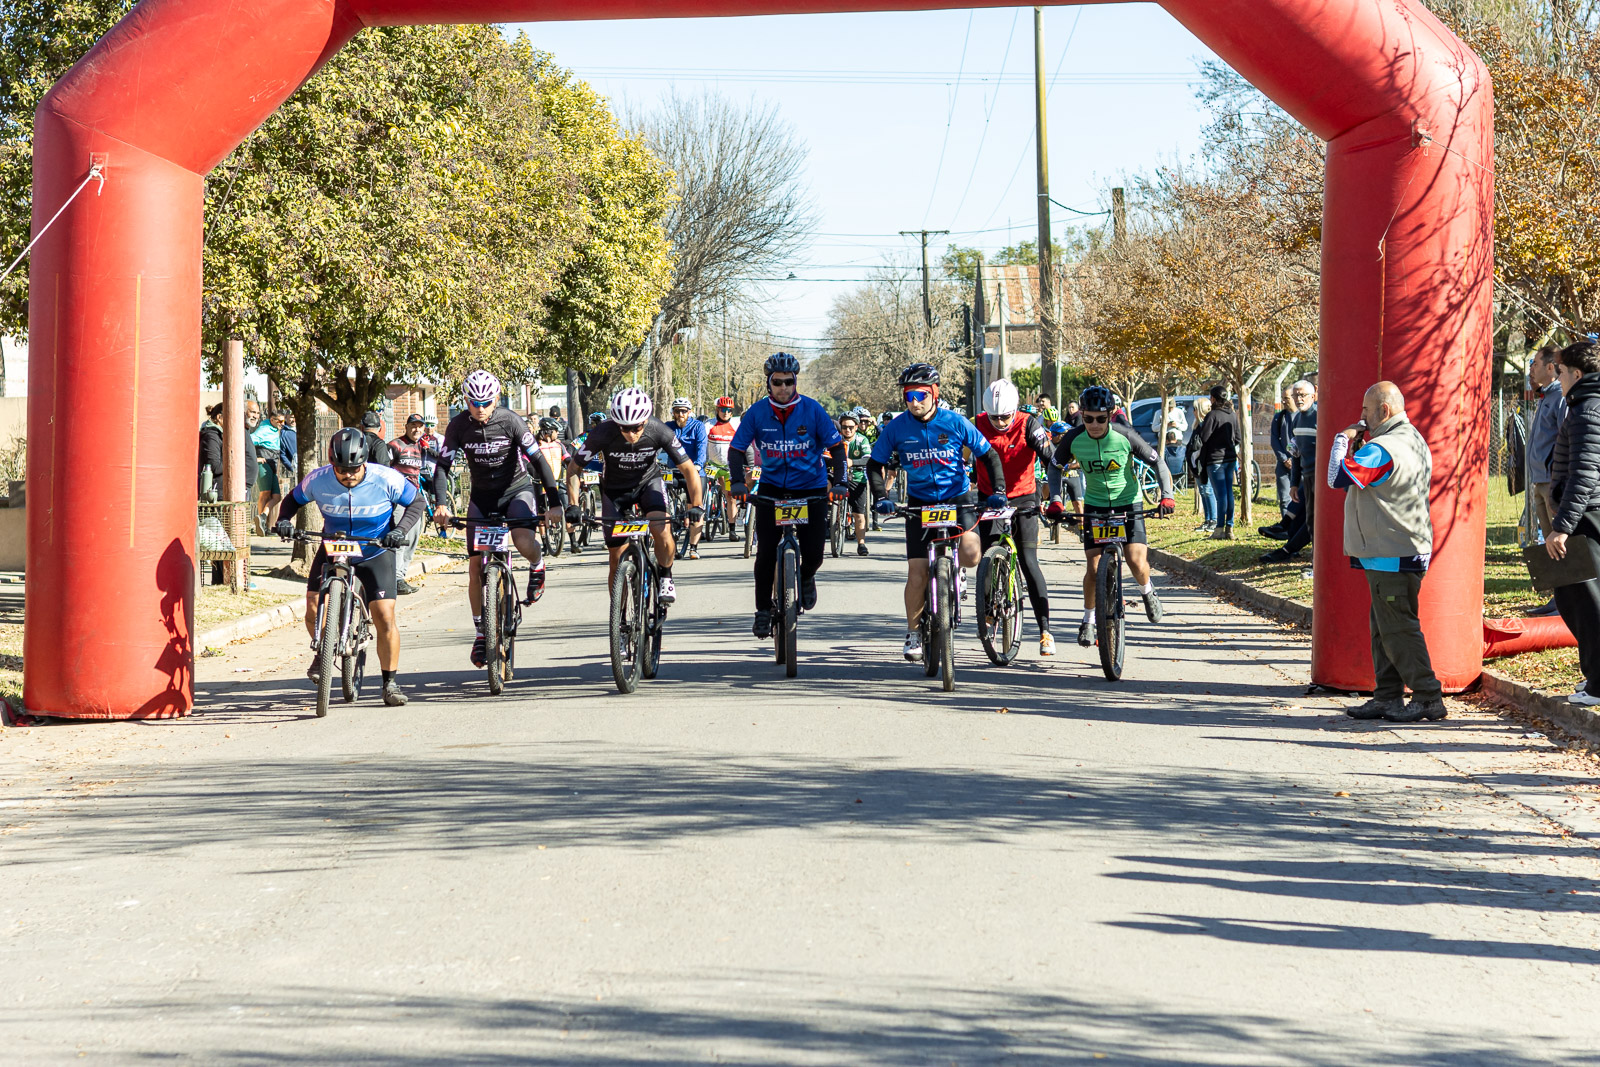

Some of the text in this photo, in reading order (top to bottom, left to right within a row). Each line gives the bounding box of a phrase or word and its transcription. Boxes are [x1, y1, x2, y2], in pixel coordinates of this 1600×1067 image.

[465, 440, 510, 449] NACHOS
[760, 440, 811, 452] PELOTON
[766, 449, 807, 458] BRUTAL
[905, 449, 954, 461] PELOTON
[912, 458, 952, 469] BRUTAL
[1080, 459, 1121, 474] USA
[321, 504, 379, 514] GIANT
[781, 506, 803, 519] 97
[928, 510, 951, 521] 98
[1099, 526, 1119, 538] 119
[478, 533, 505, 545] 215
